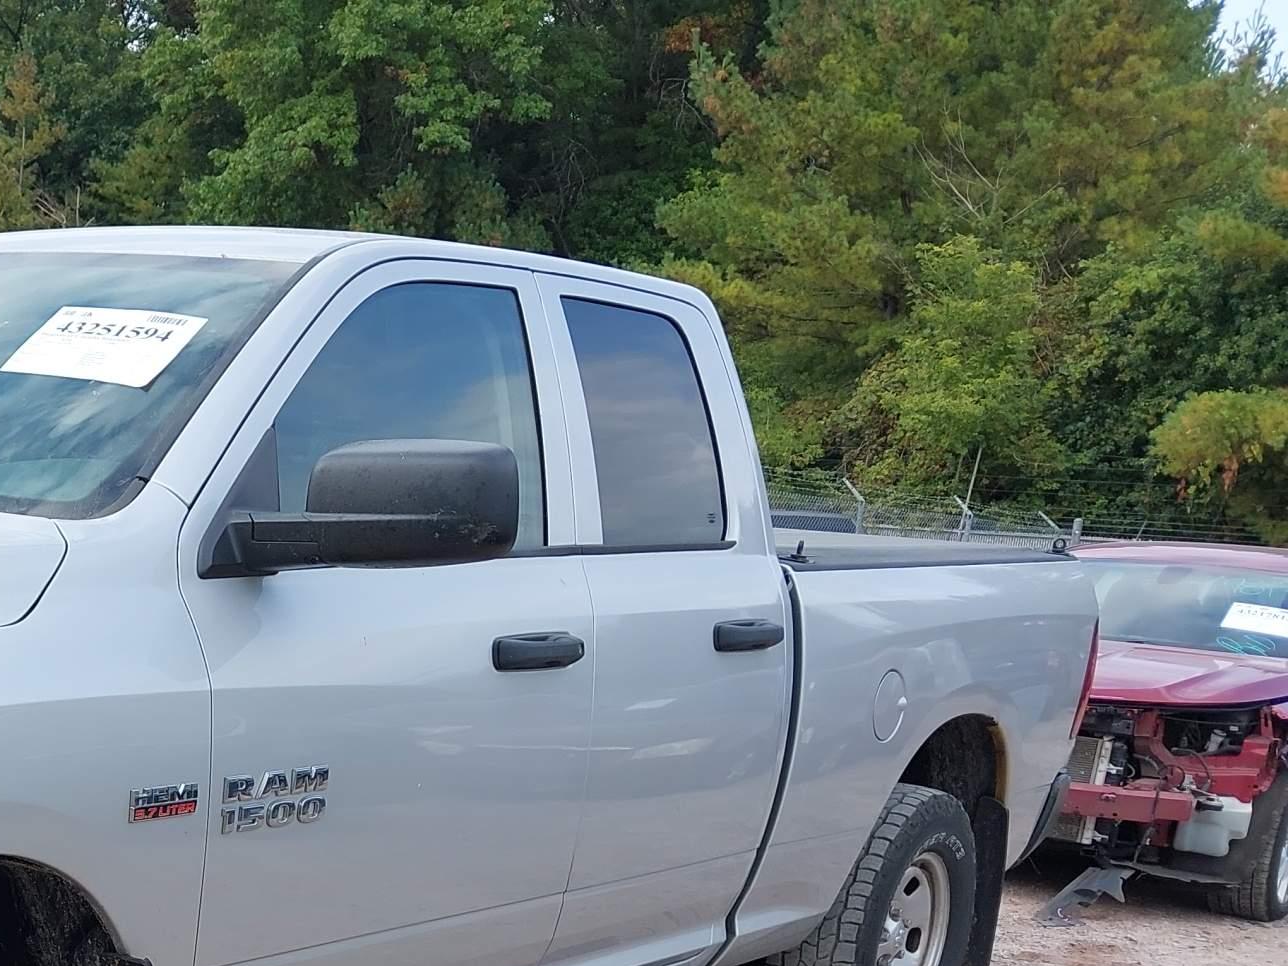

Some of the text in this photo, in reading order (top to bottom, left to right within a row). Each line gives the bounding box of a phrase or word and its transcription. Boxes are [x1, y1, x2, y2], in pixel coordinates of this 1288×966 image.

[56, 321, 173, 342] 43251594
[130, 783, 199, 806] HEMI
[222, 765, 329, 803] RAM
[134, 802, 197, 821] 5.7 LITER
[221, 795, 327, 834] 1500
